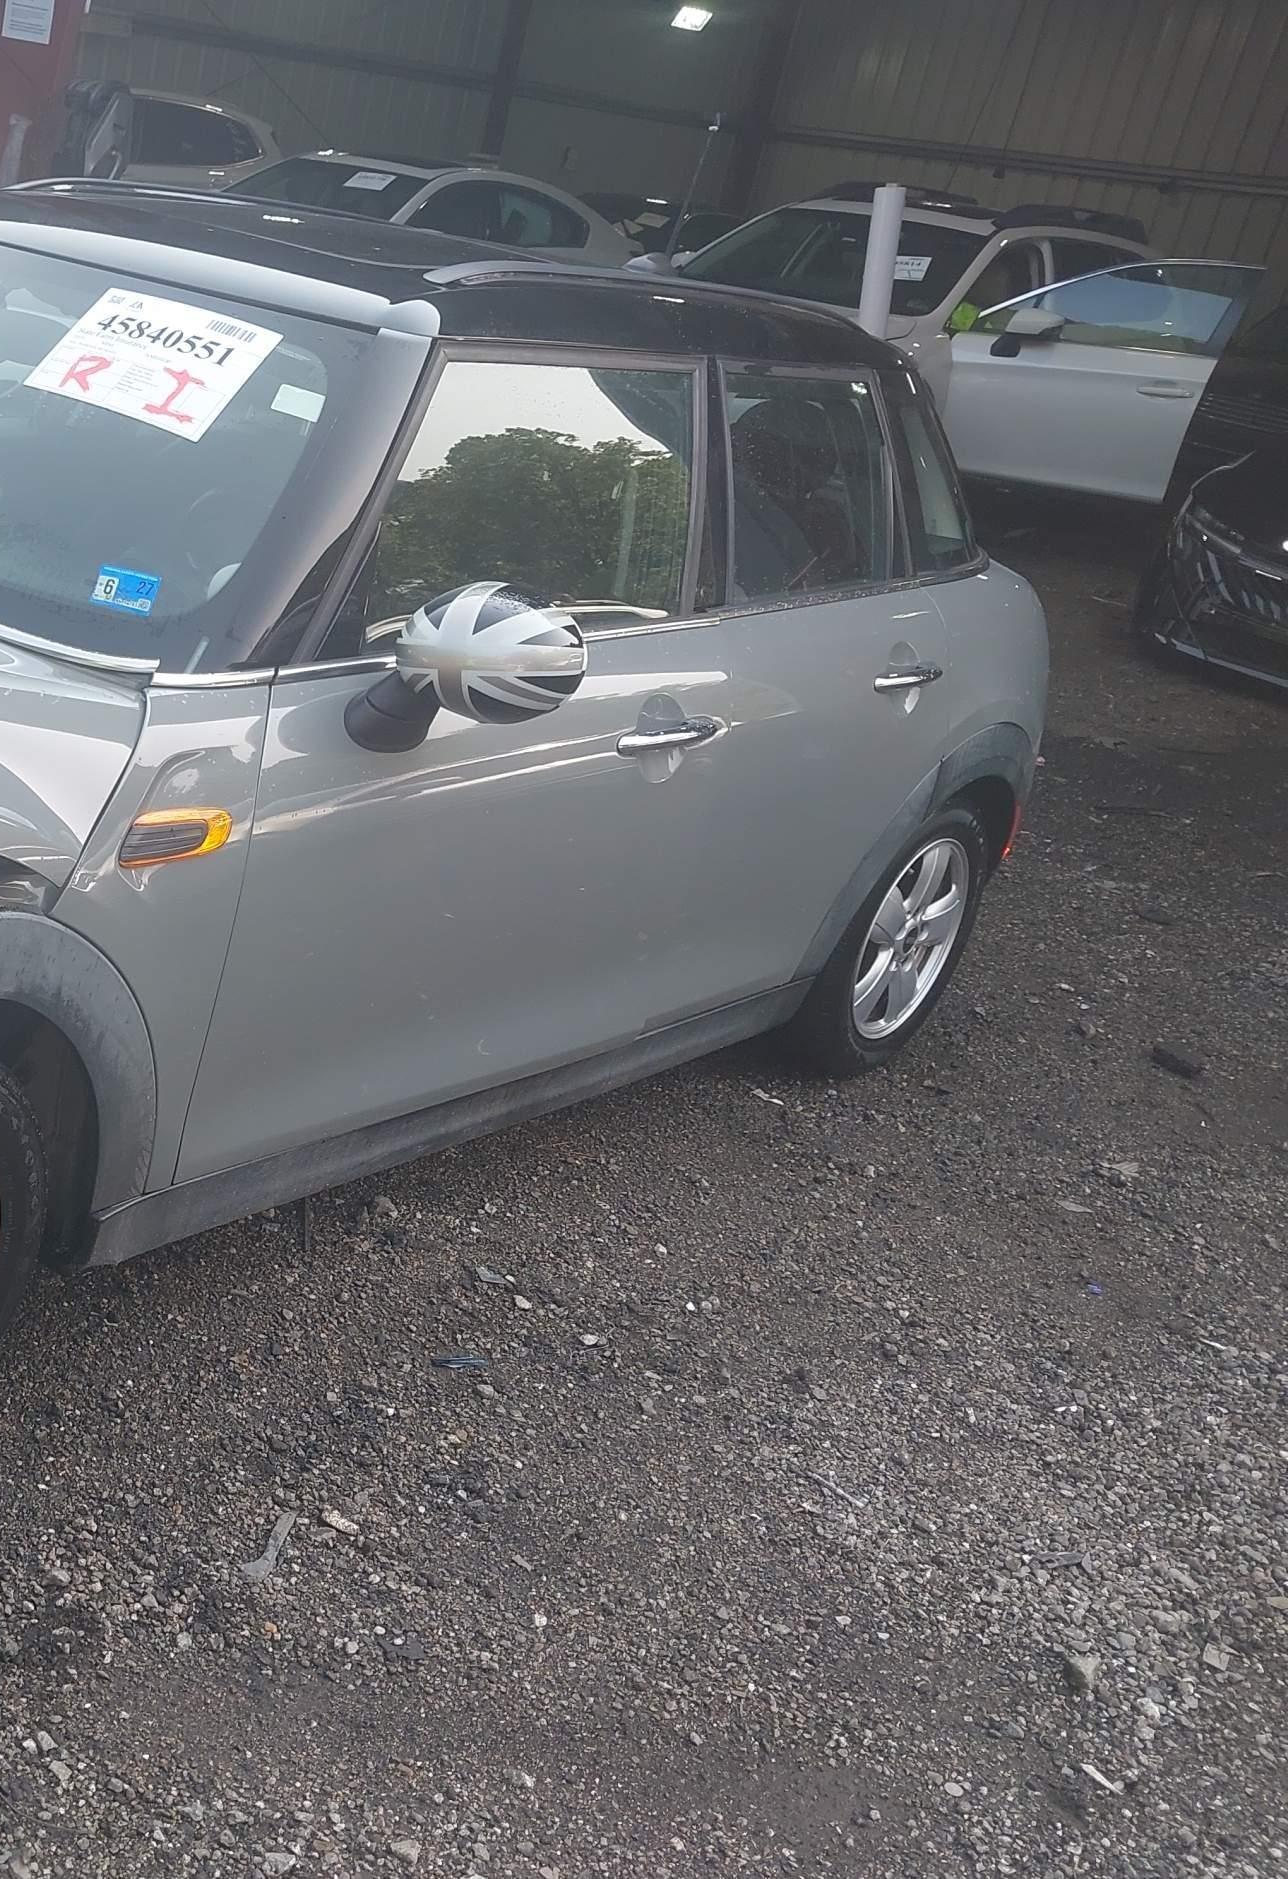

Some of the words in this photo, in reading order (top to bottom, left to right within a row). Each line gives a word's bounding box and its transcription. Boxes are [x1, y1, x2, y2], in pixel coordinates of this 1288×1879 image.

[97, 313, 235, 368] 45840551
[59, 353, 114, 393] R
[142, 367, 207, 424] I
[103, 579, 116, 595] 6
[136, 581, 154, 596] 27
